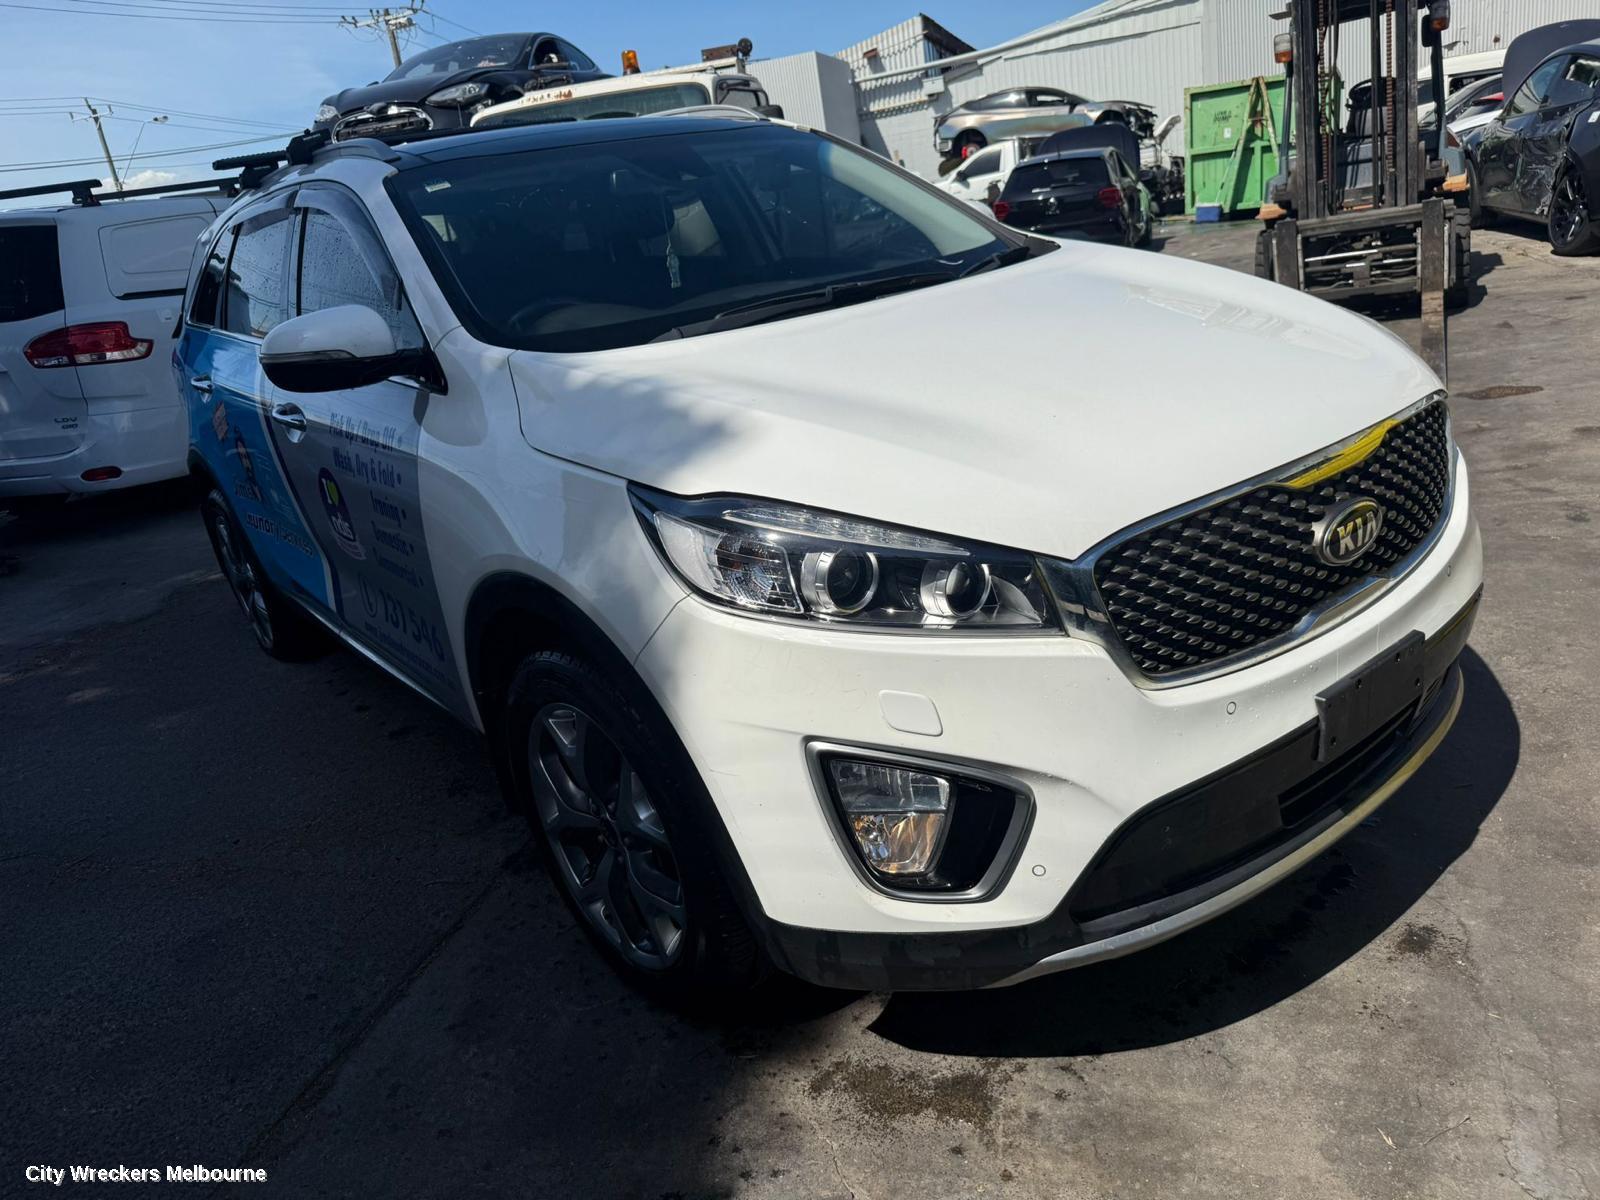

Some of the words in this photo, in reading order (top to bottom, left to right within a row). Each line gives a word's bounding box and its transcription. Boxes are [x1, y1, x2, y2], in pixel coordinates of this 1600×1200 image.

[329, 411, 344, 437] Pick
[345, 415, 354, 446] Up
[361, 420, 380, 454] Drop
[381, 426, 396, 453] Off
[356, 453, 370, 485] Dry
[378, 460, 396, 489] Fold
[1336, 510, 1377, 556] KIA
